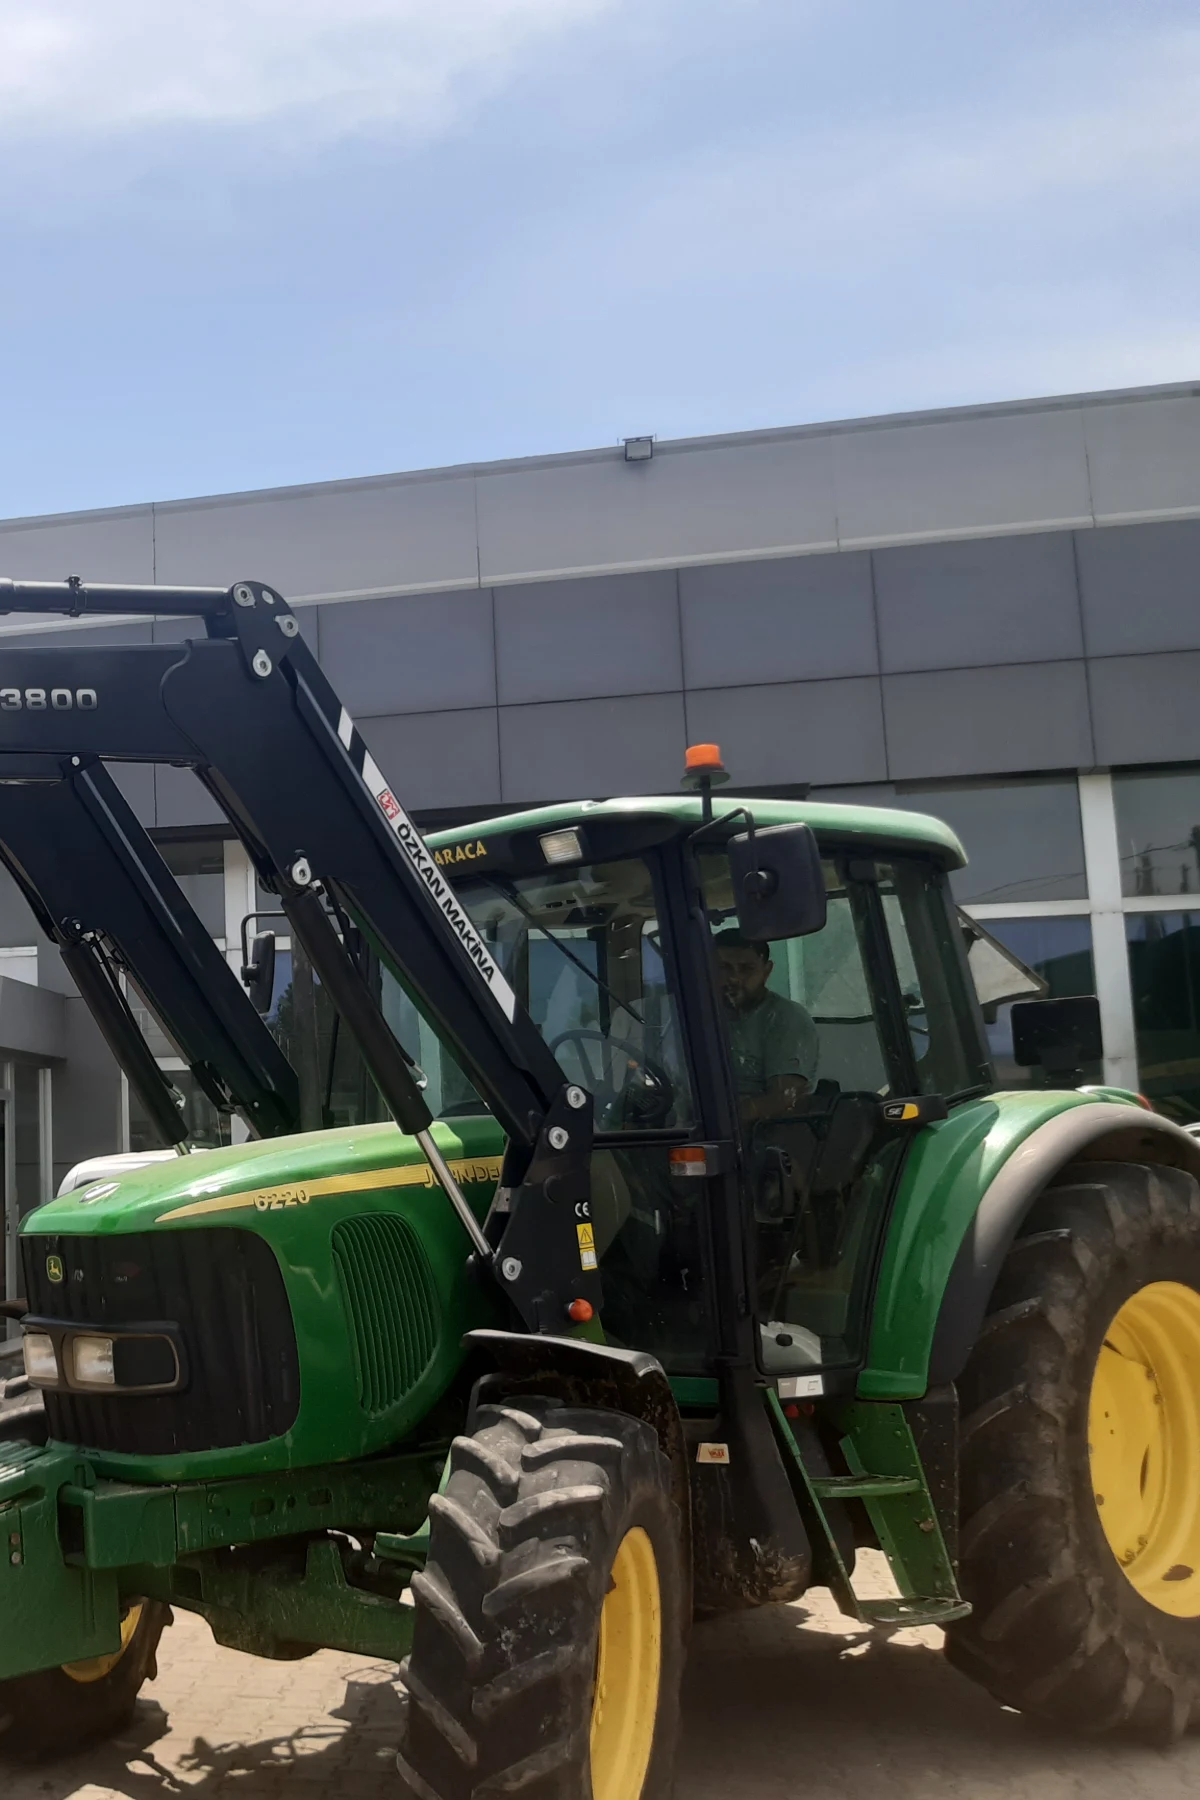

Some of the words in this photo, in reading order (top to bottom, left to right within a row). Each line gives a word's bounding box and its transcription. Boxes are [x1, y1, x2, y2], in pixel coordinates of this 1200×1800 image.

[0, 688, 98, 711] 3800
[397, 823, 446, 898] ÖZKAN
[442, 898, 495, 983] MAKİNA
[253, 1187, 310, 1211] 6220
